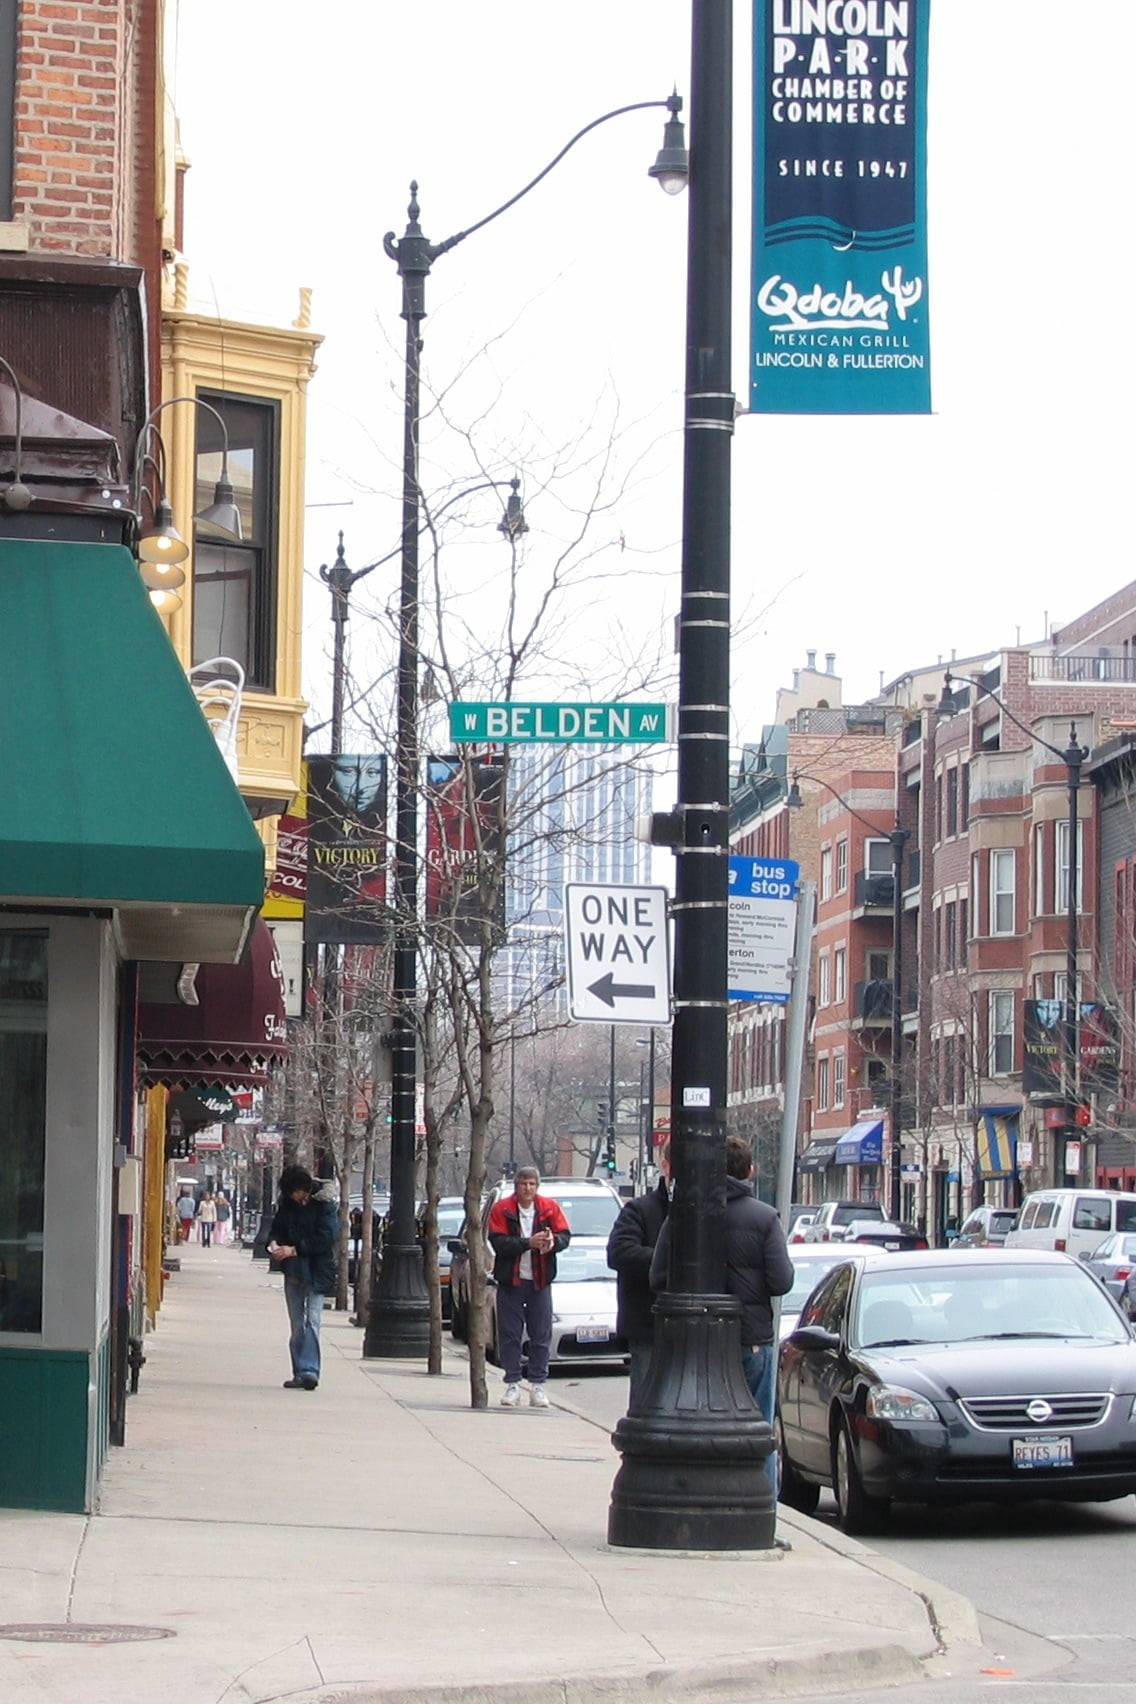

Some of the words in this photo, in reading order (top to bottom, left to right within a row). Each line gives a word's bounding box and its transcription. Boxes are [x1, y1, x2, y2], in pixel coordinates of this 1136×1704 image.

[772, 0, 909, 37] LINCOLN
[771, 78, 873, 100] CHAMBER
[879, 80, 908, 101] OF
[772, 101, 906, 125] COMMERCE
[778, 159, 844, 178] SINCE
[858, 160, 908, 179] 1947
[757, 274, 889, 326] Qdoba
[773, 333, 853, 347] MEXICAN
[859, 335, 910, 348] GRILL
[755, 352, 823, 368] LINCOLN
[827, 353, 839, 368] &
[843, 353, 924, 369] FULLERTON
[464, 713, 477, 731] W
[486, 707, 631, 738] BELDEN
[639, 714, 659, 731] AV
[314, 848, 380, 864] VICTORY
[751, 862, 785, 880] bus
[750, 879, 791, 899] stop
[581, 894, 654, 927] ONE
[579, 931, 657, 965] WAY
[1015, 1446, 1050, 1462] REYES
[1056, 1445, 1069, 1461] 71
